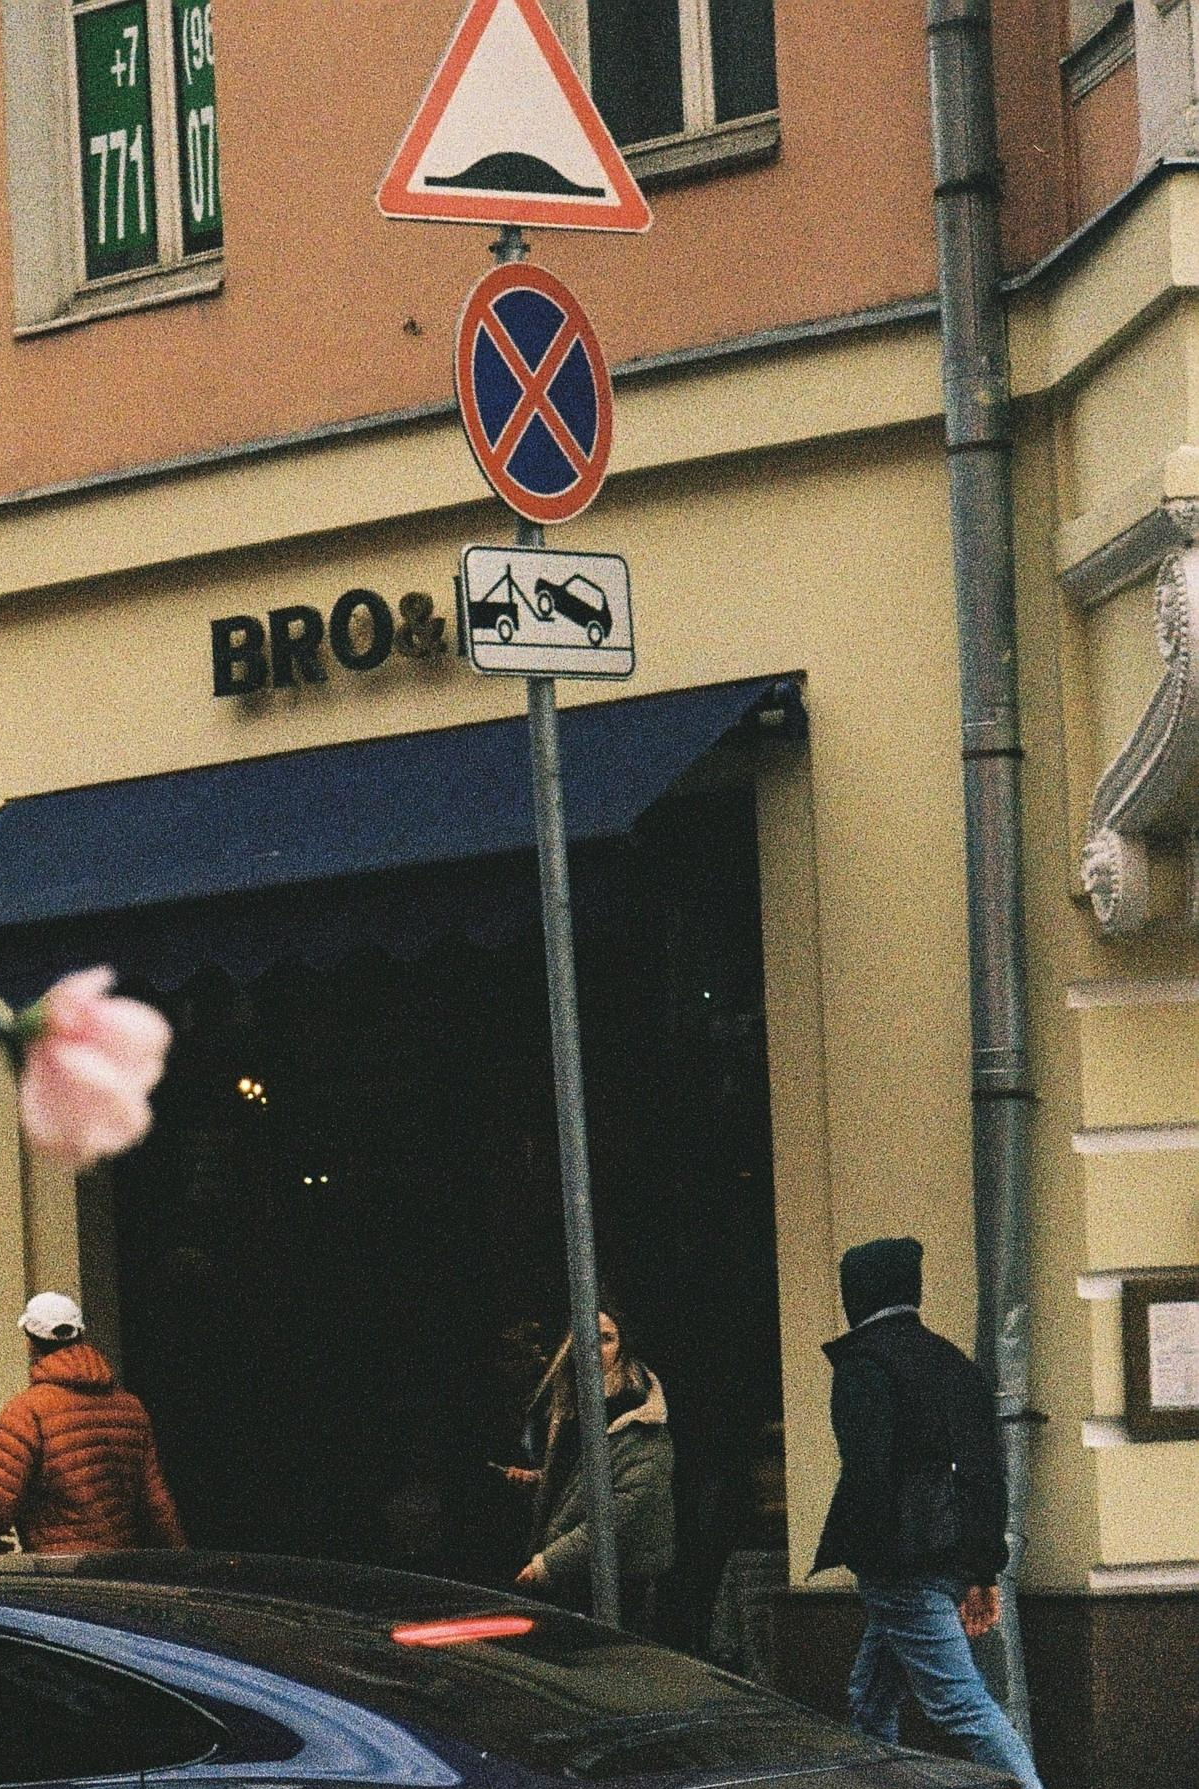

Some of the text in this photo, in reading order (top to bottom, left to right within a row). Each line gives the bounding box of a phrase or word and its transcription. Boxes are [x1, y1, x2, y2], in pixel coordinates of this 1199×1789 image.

[109, 25, 139, 88] +7
[89, 105, 215, 244] 771 07
[210, 576, 469, 698] BRO&
